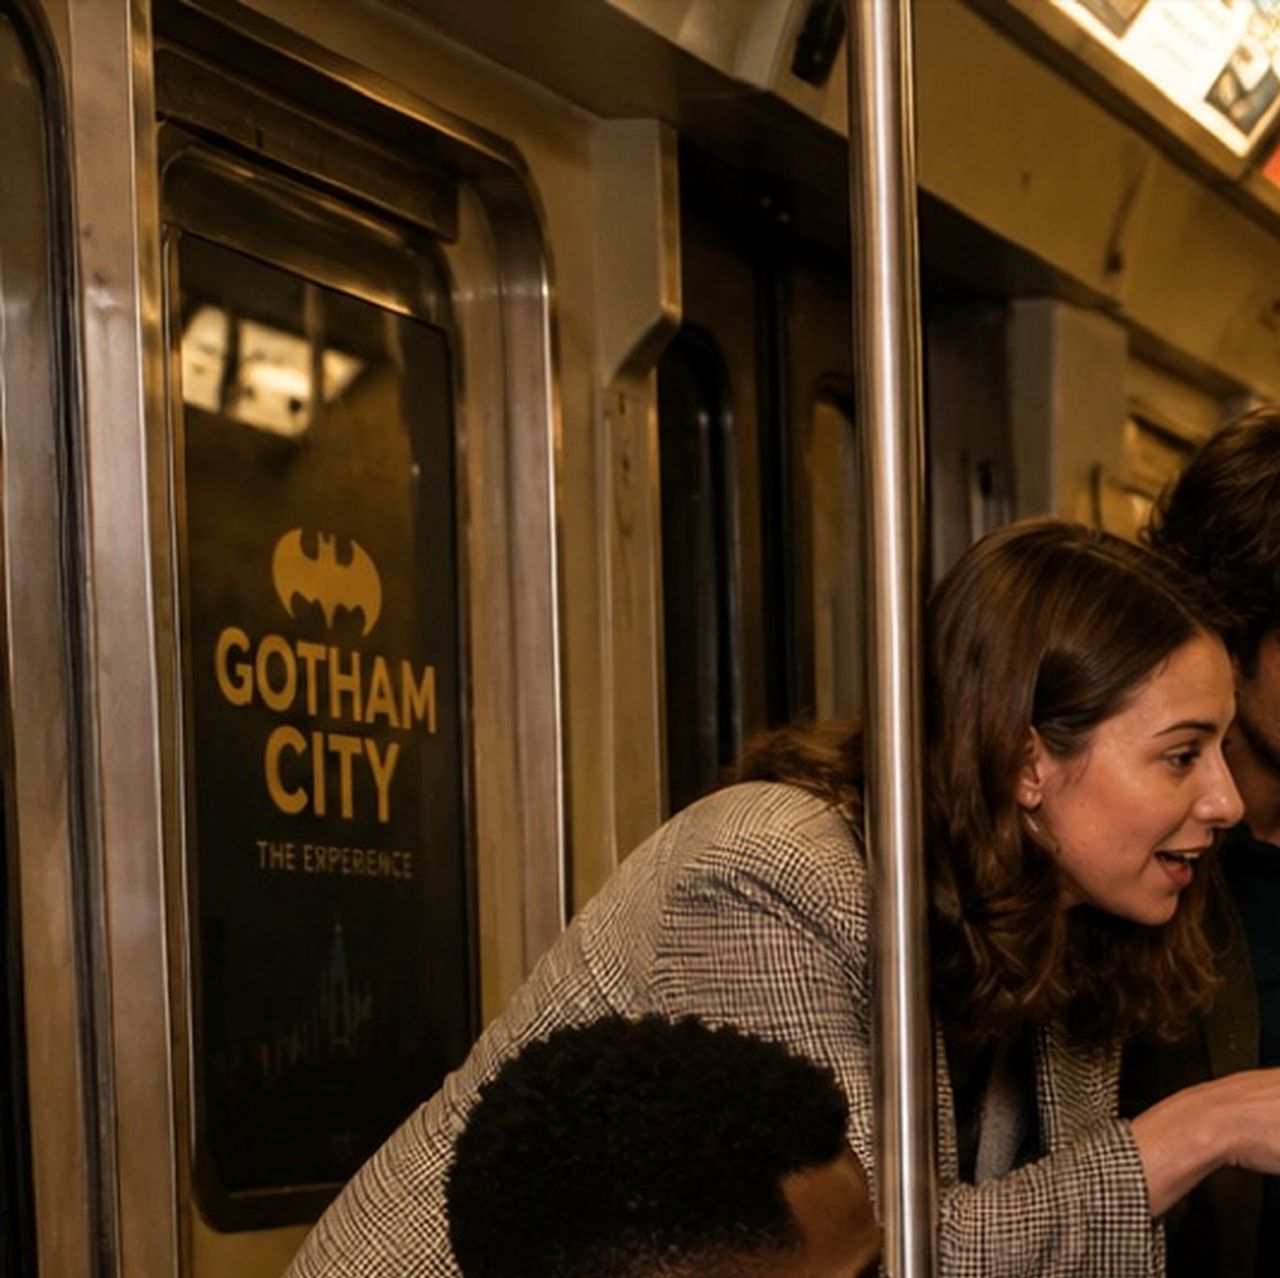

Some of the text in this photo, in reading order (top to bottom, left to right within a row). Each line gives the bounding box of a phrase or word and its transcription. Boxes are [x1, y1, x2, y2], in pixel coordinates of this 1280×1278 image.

[215, 626, 437, 734] GOTHAM
[265, 726, 400, 823] CITY
[256, 840, 295, 870] THE
